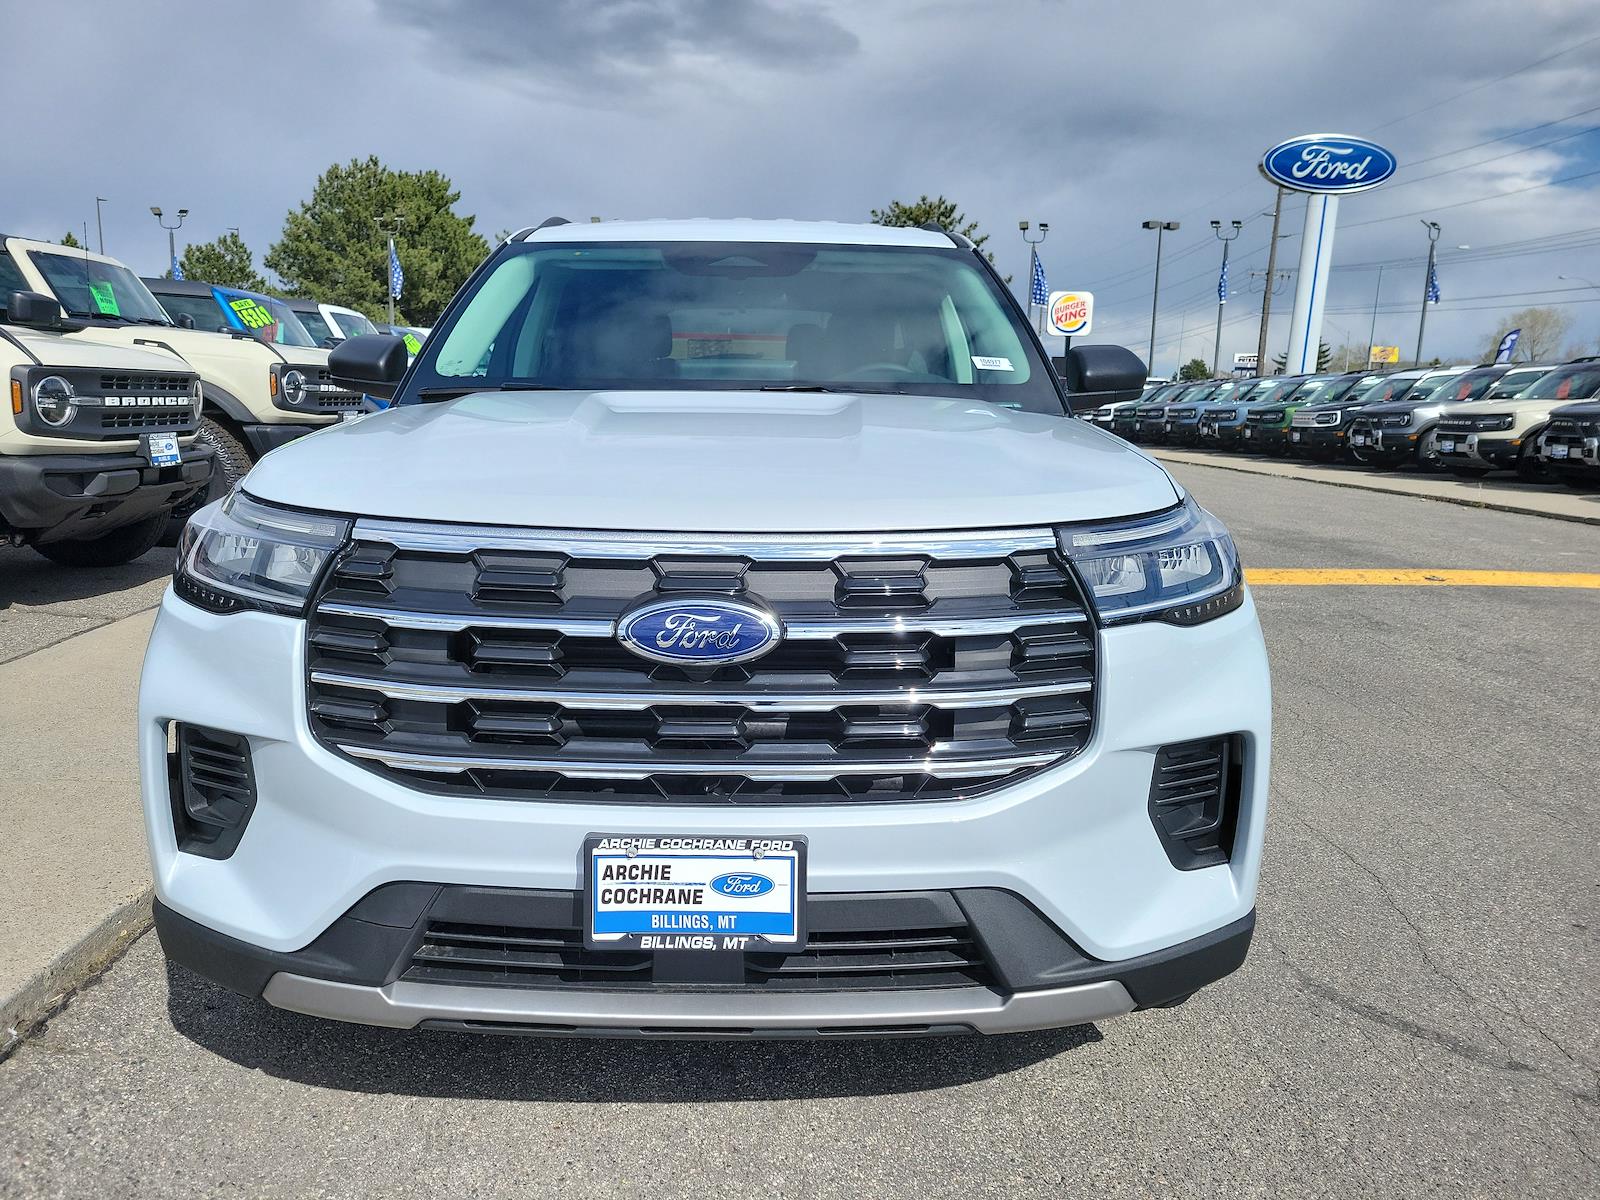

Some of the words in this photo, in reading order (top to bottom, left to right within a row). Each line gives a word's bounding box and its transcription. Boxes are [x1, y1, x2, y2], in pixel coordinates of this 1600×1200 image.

[1291, 145, 1373, 180] Ford
[1055, 301, 1086, 315] BURGER
[1056, 308, 1086, 325] KING
[105, 396, 189, 406] BRONCO
[655, 613, 742, 650] Ford
[598, 838, 656, 850] ARCHIE
[659, 838, 745, 850] COCHRANE
[749, 839, 794, 851] FORD
[602, 864, 672, 881] ARCHIE
[722, 875, 762, 893] Ford
[601, 888, 704, 905] COCHRANE
[651, 914, 714, 931] BILLINGS,
[717, 915, 737, 929] MT
[640, 936, 717, 951] BILLINGS,
[722, 937, 749, 950] MT
